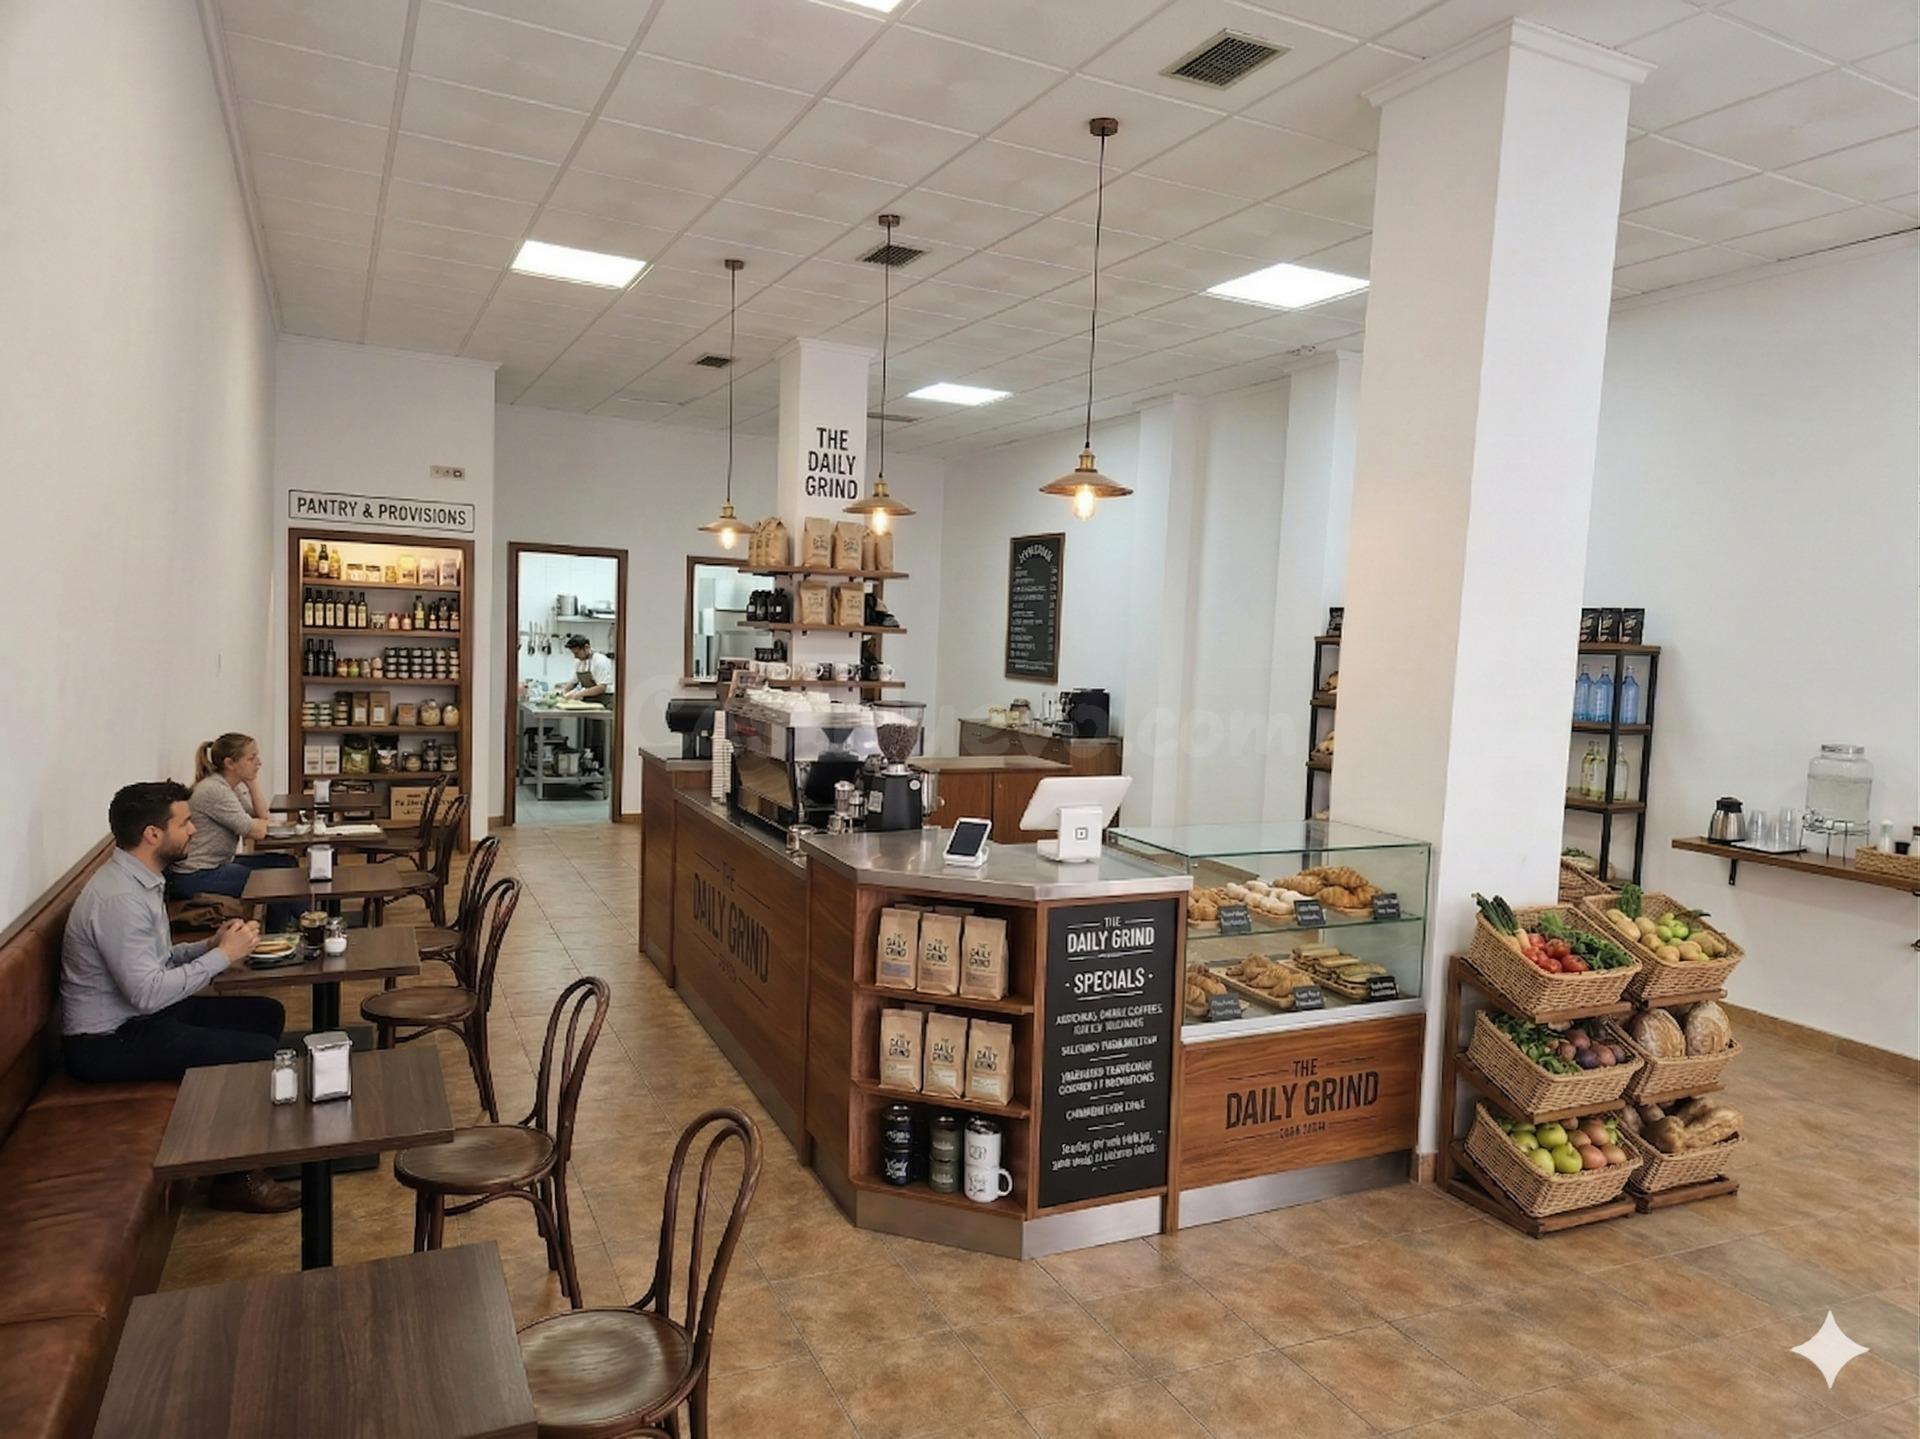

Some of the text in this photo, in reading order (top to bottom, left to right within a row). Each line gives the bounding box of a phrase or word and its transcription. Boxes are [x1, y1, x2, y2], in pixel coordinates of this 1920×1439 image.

[816, 427, 849, 451] THE
[808, 451, 856, 475] DAILY
[805, 475, 858, 499] GRIND
[297, 497, 466, 526] PANTRY & PROVISIONS
[693, 871, 770, 984] DAILY GRIND
[1067, 926, 1155, 953] DAILY GRIND
[1073, 967, 1145, 994] SPECIALS
[1293, 1058, 1319, 1078] THE
[1225, 1070, 1380, 1130] DAILY GRIND
